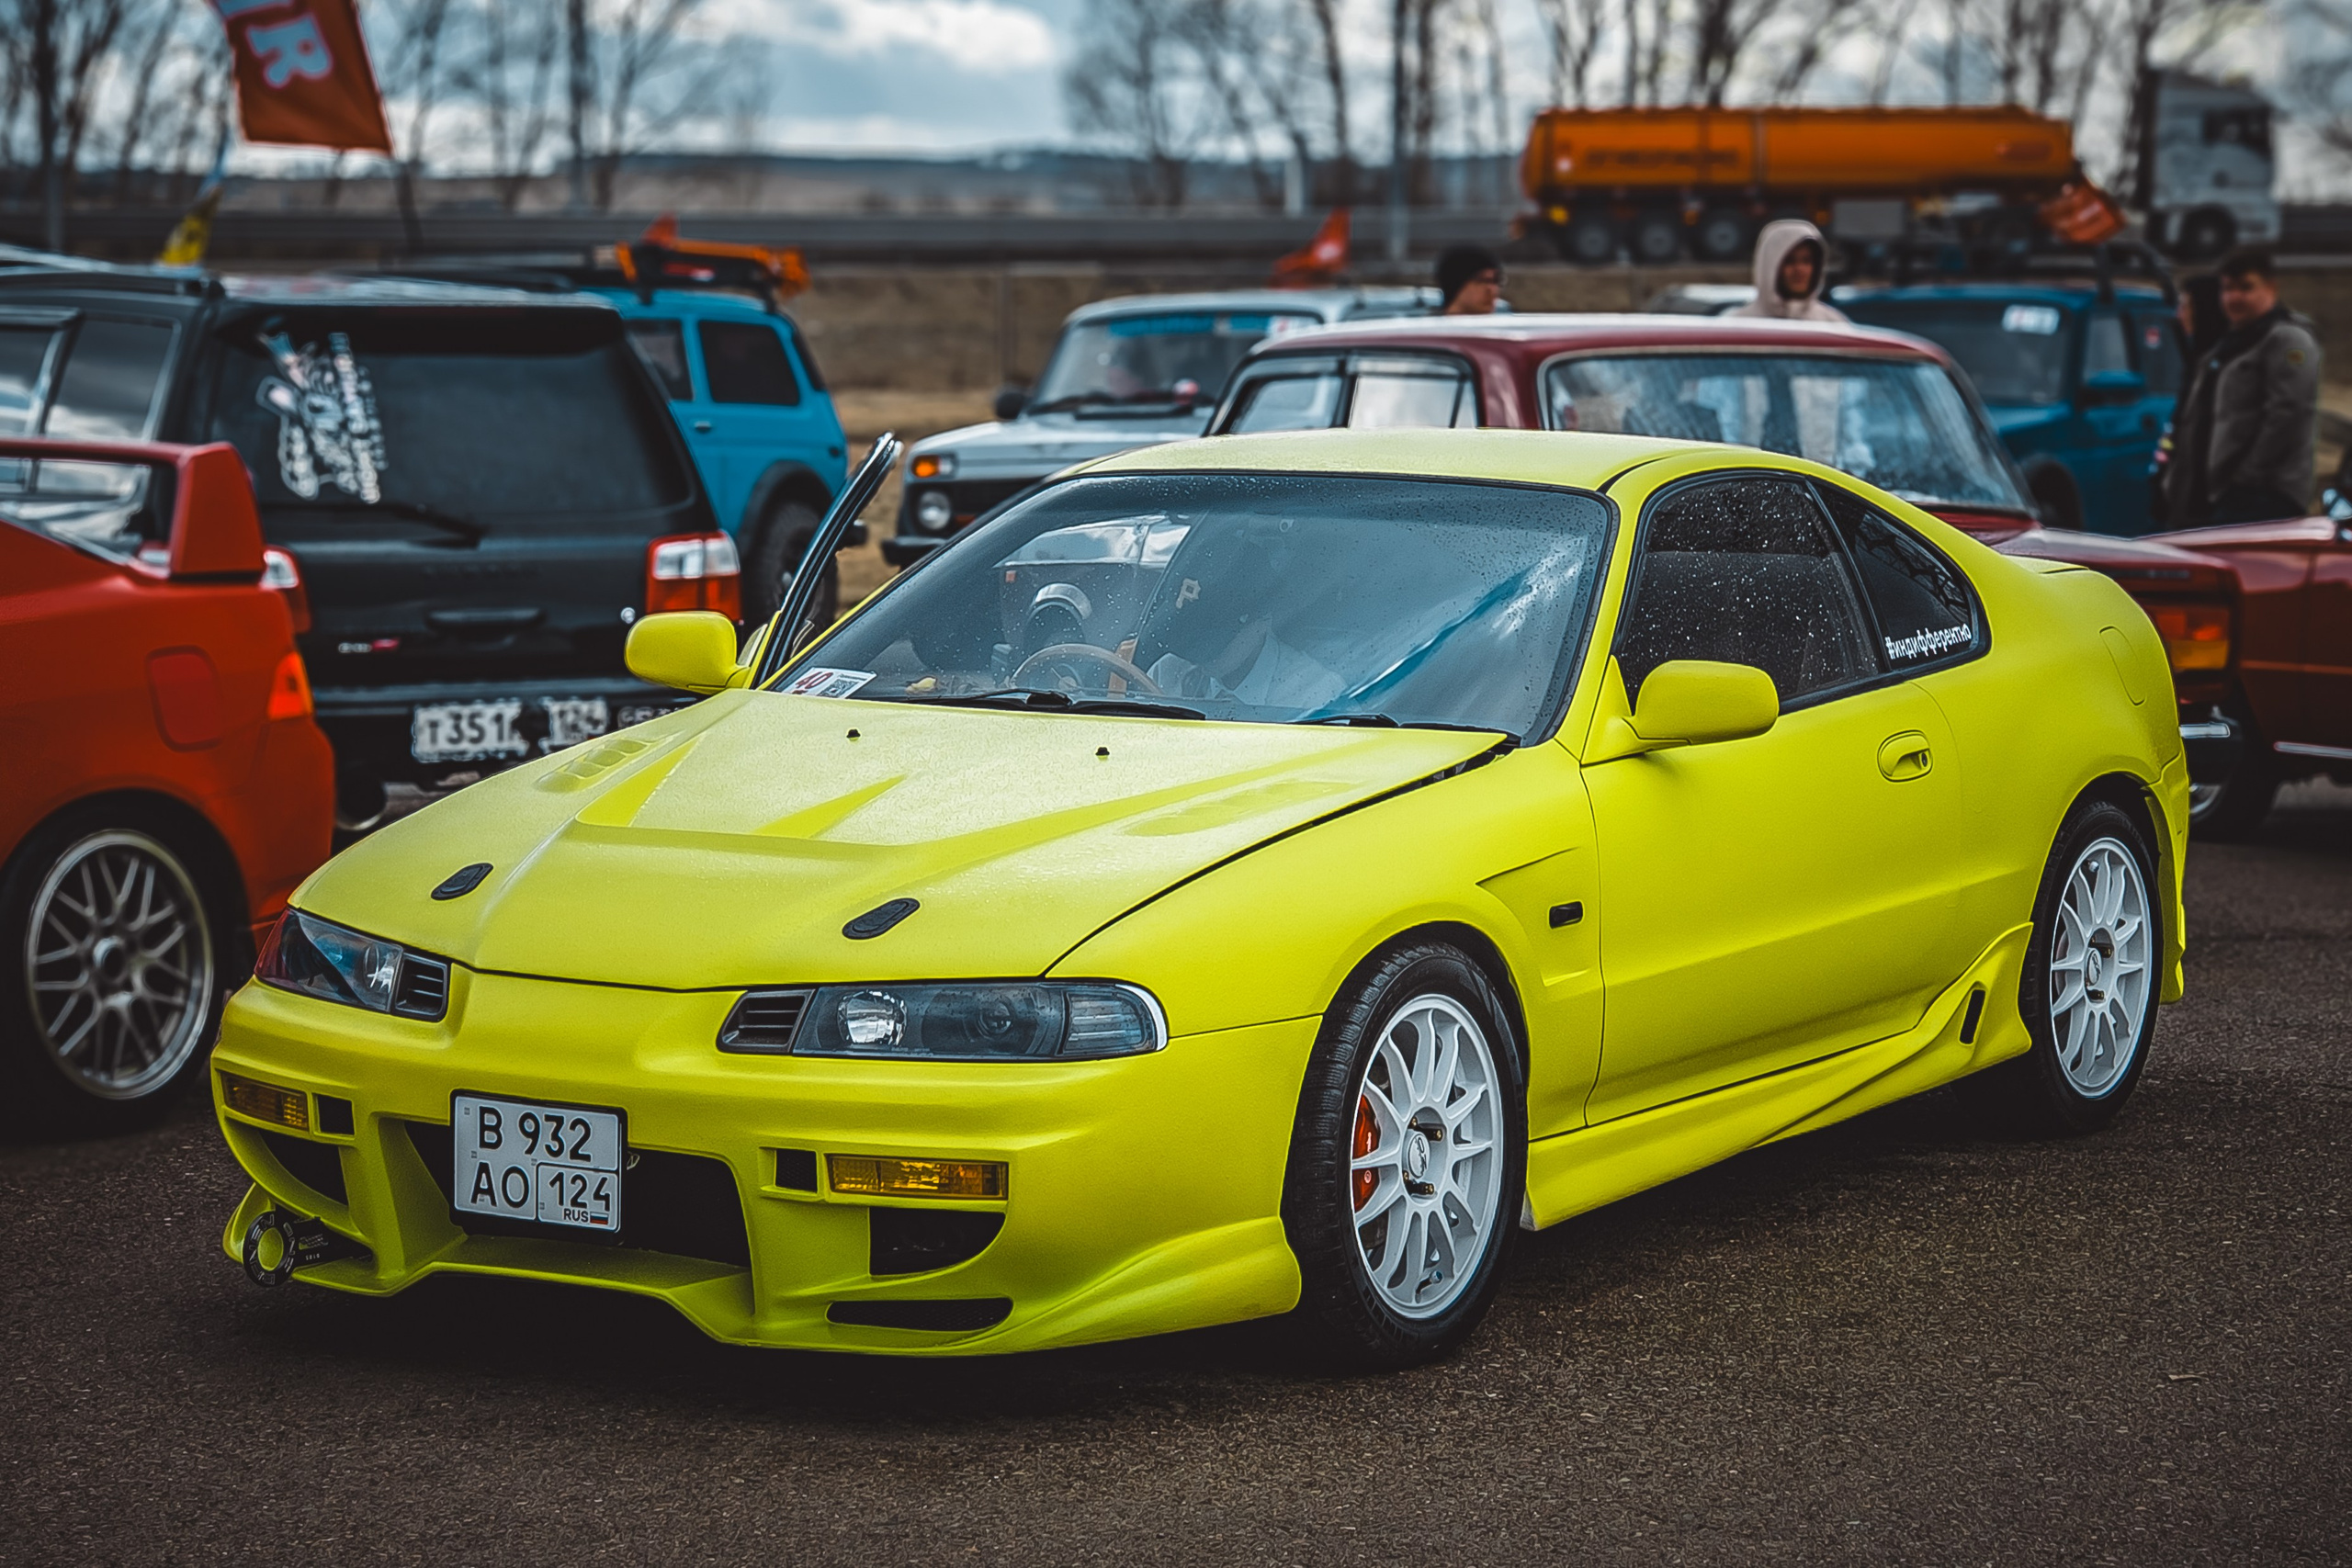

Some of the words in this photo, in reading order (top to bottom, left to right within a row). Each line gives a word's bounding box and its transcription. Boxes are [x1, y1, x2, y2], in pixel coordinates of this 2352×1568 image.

[1884, 623, 1973, 660] #индифферентно
[795, 671, 834, 689] 40
[479, 1105, 503, 1150] B
[518, 1111, 592, 1163] 932
[470, 1161, 530, 1209] AO
[548, 1171, 611, 1213] 124
[563, 1207, 589, 1223] RUS
